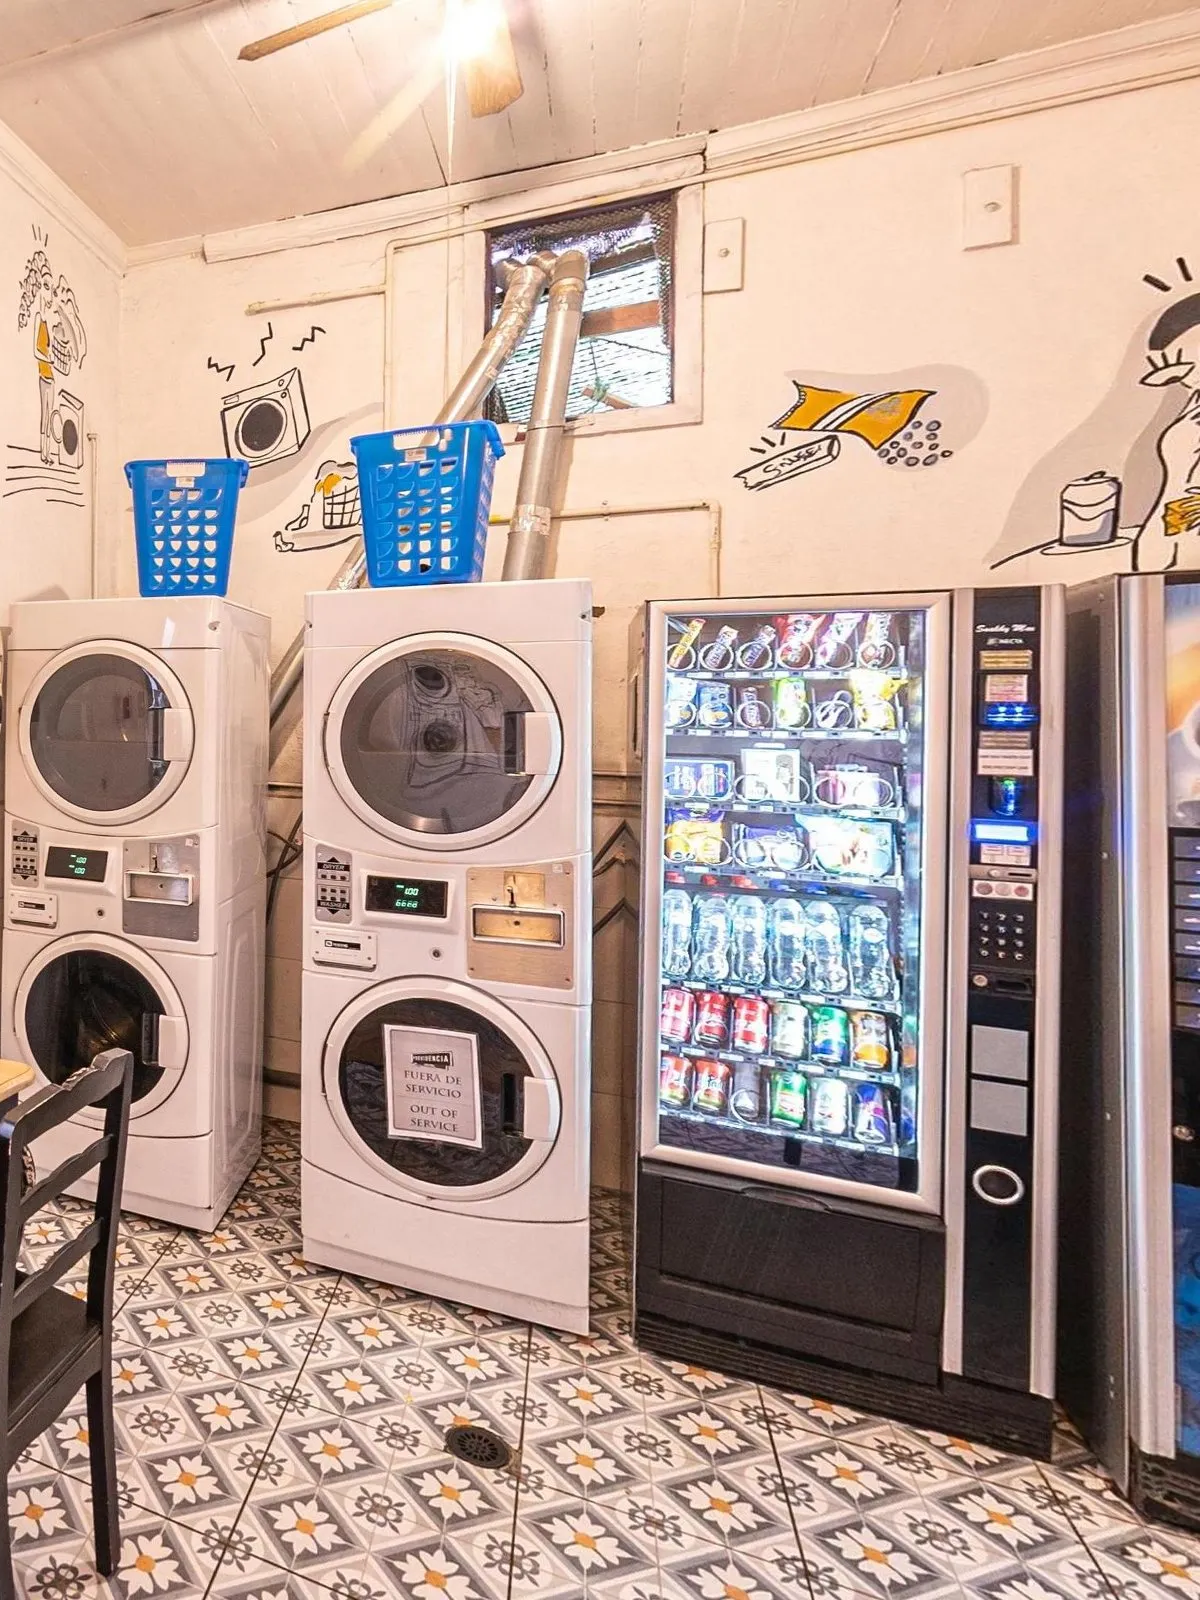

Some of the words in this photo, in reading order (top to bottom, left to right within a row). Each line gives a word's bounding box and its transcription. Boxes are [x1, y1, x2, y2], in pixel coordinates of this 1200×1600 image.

[322, 863, 345, 871] DRYER
[320, 901, 347, 909] WASHER
[404, 1070, 441, 1082] FUERA
[446, 1075, 462, 1085] DE
[406, 1084, 461, 1098] SERVICIO
[410, 1104, 437, 1115] OUT
[441, 1108, 458, 1118] OF
[410, 1118, 459, 1132] SERVICE
